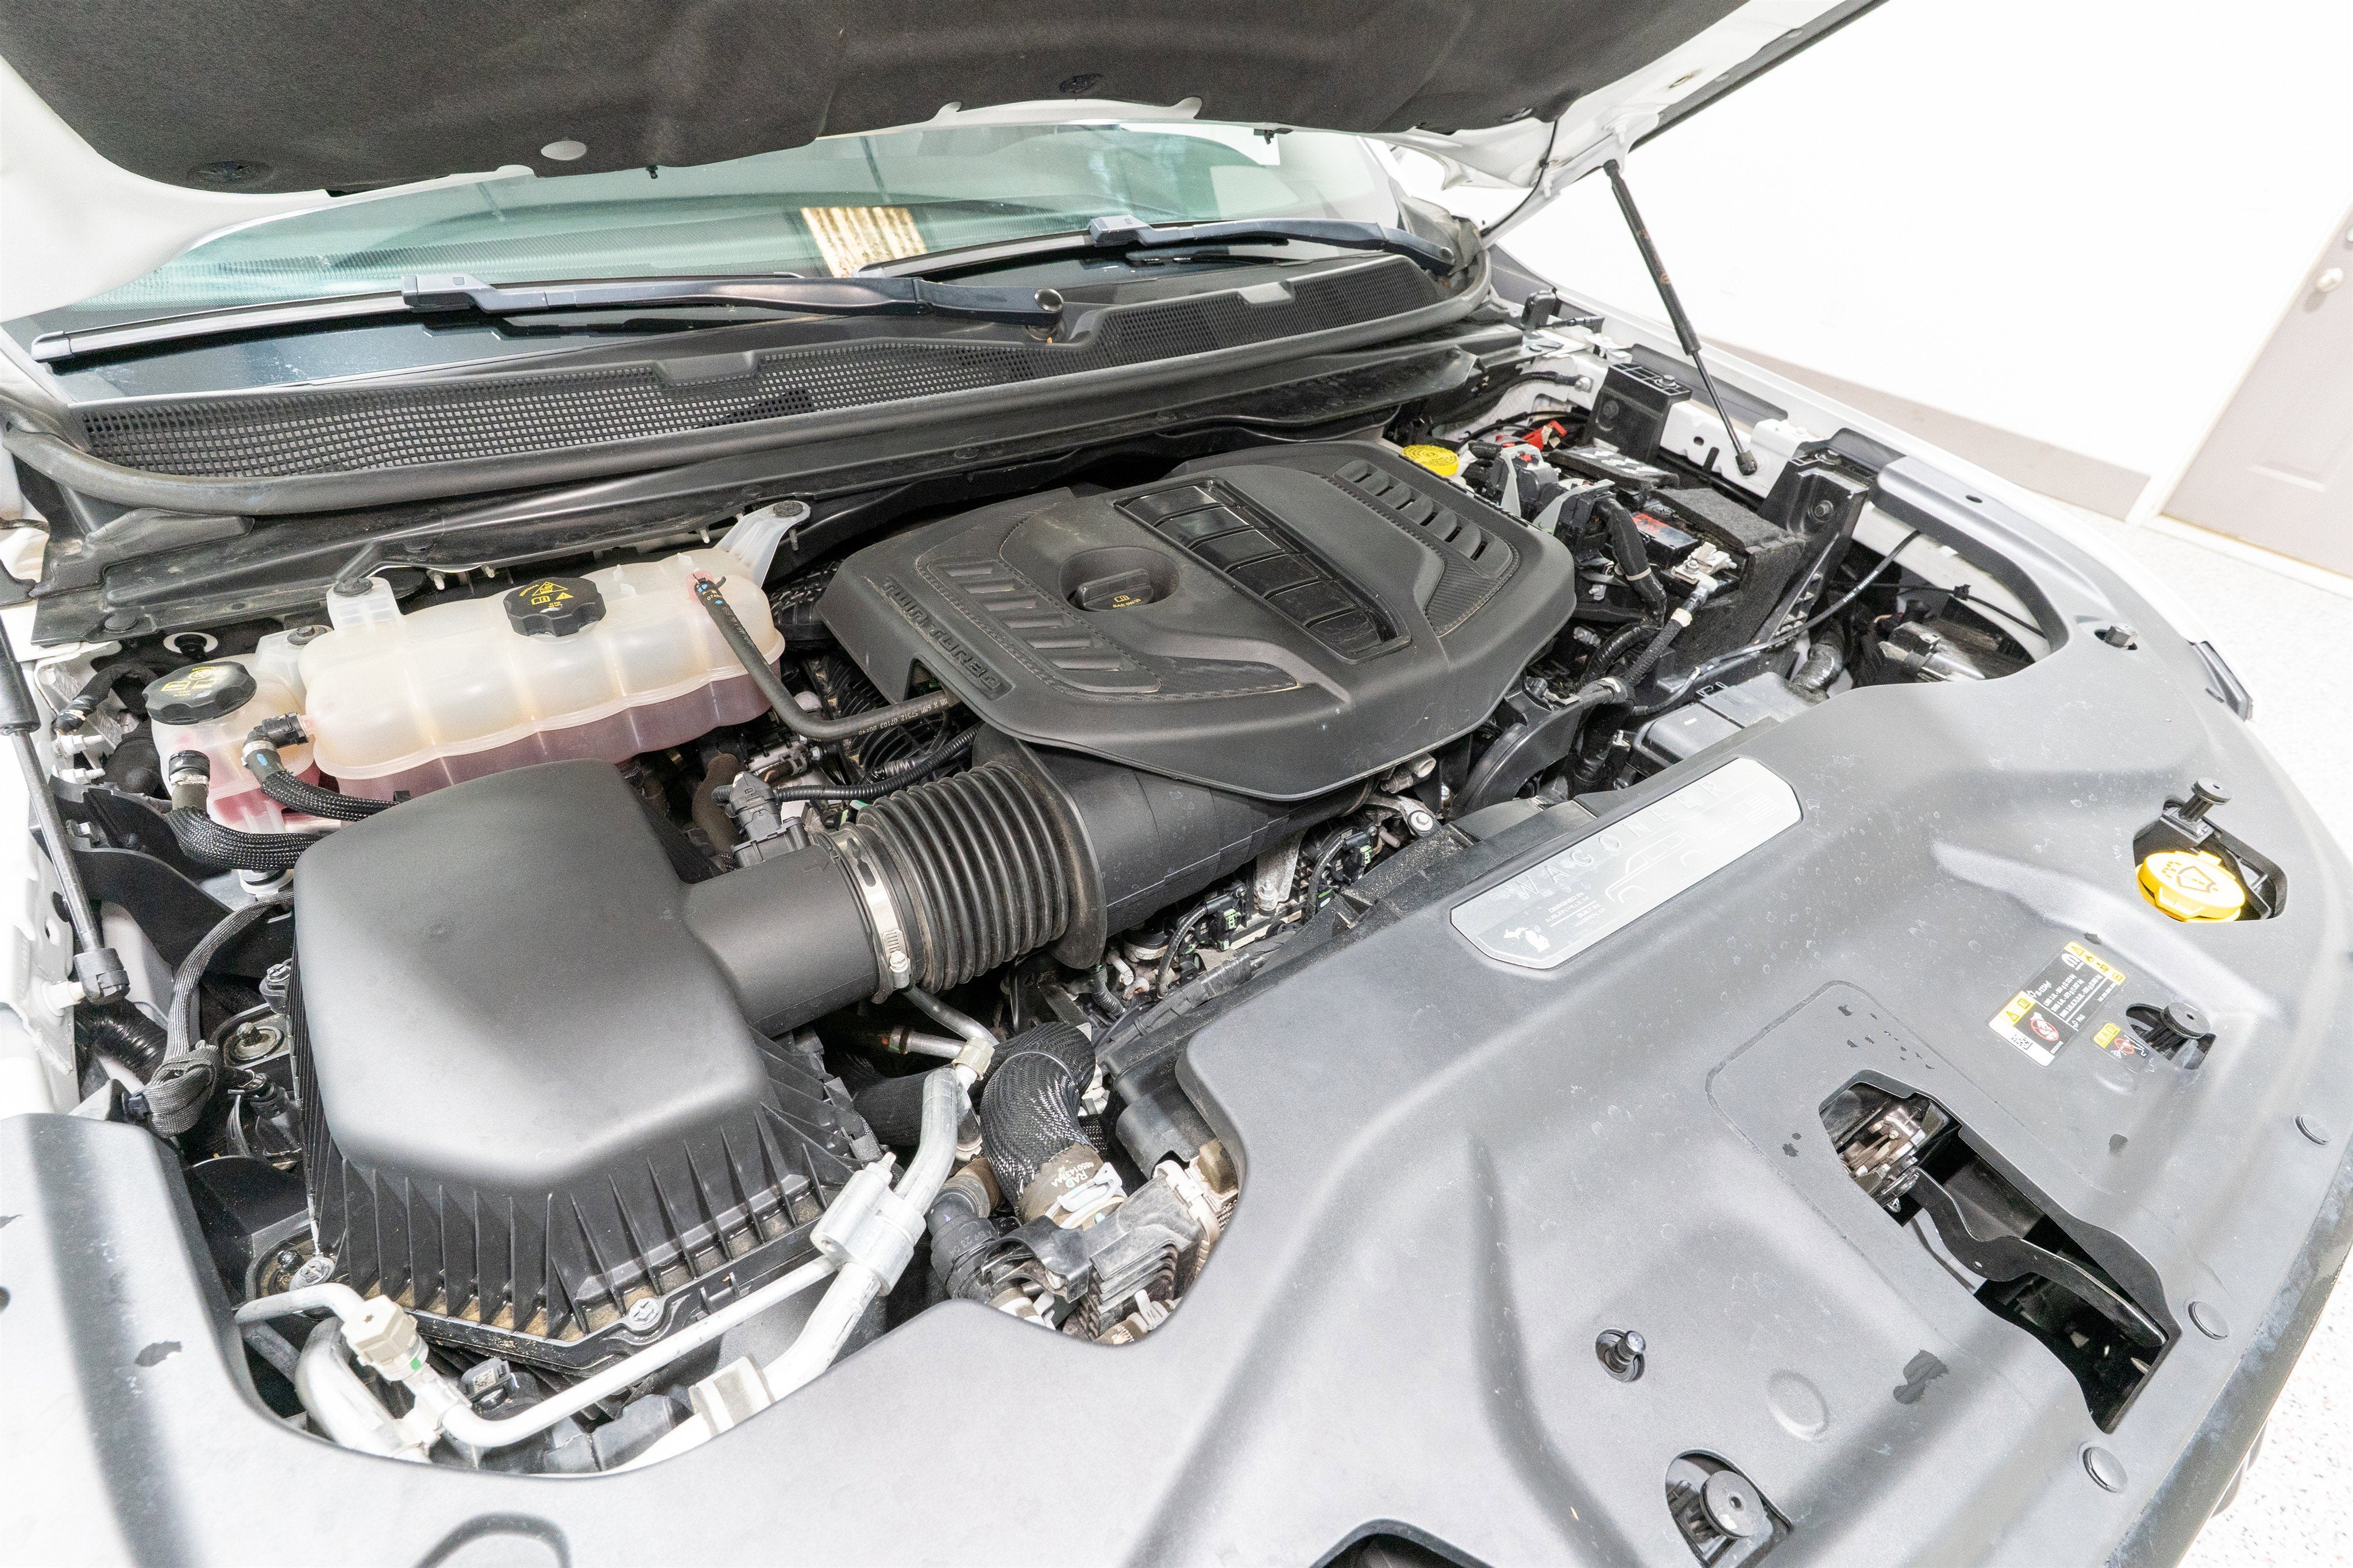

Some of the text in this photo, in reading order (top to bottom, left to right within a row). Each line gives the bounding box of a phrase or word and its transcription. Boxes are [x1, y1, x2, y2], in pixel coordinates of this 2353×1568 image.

[884, 577, 1002, 690] TWIN TURBO
[1506, 779, 1725, 900] WAGONEER
[1548, 895, 1577, 913] DESIGNED
[1576, 907, 1592, 918] BUILT
[1545, 907, 1567, 923] AUBURN
[1066, 1170, 1088, 1188] RAD
